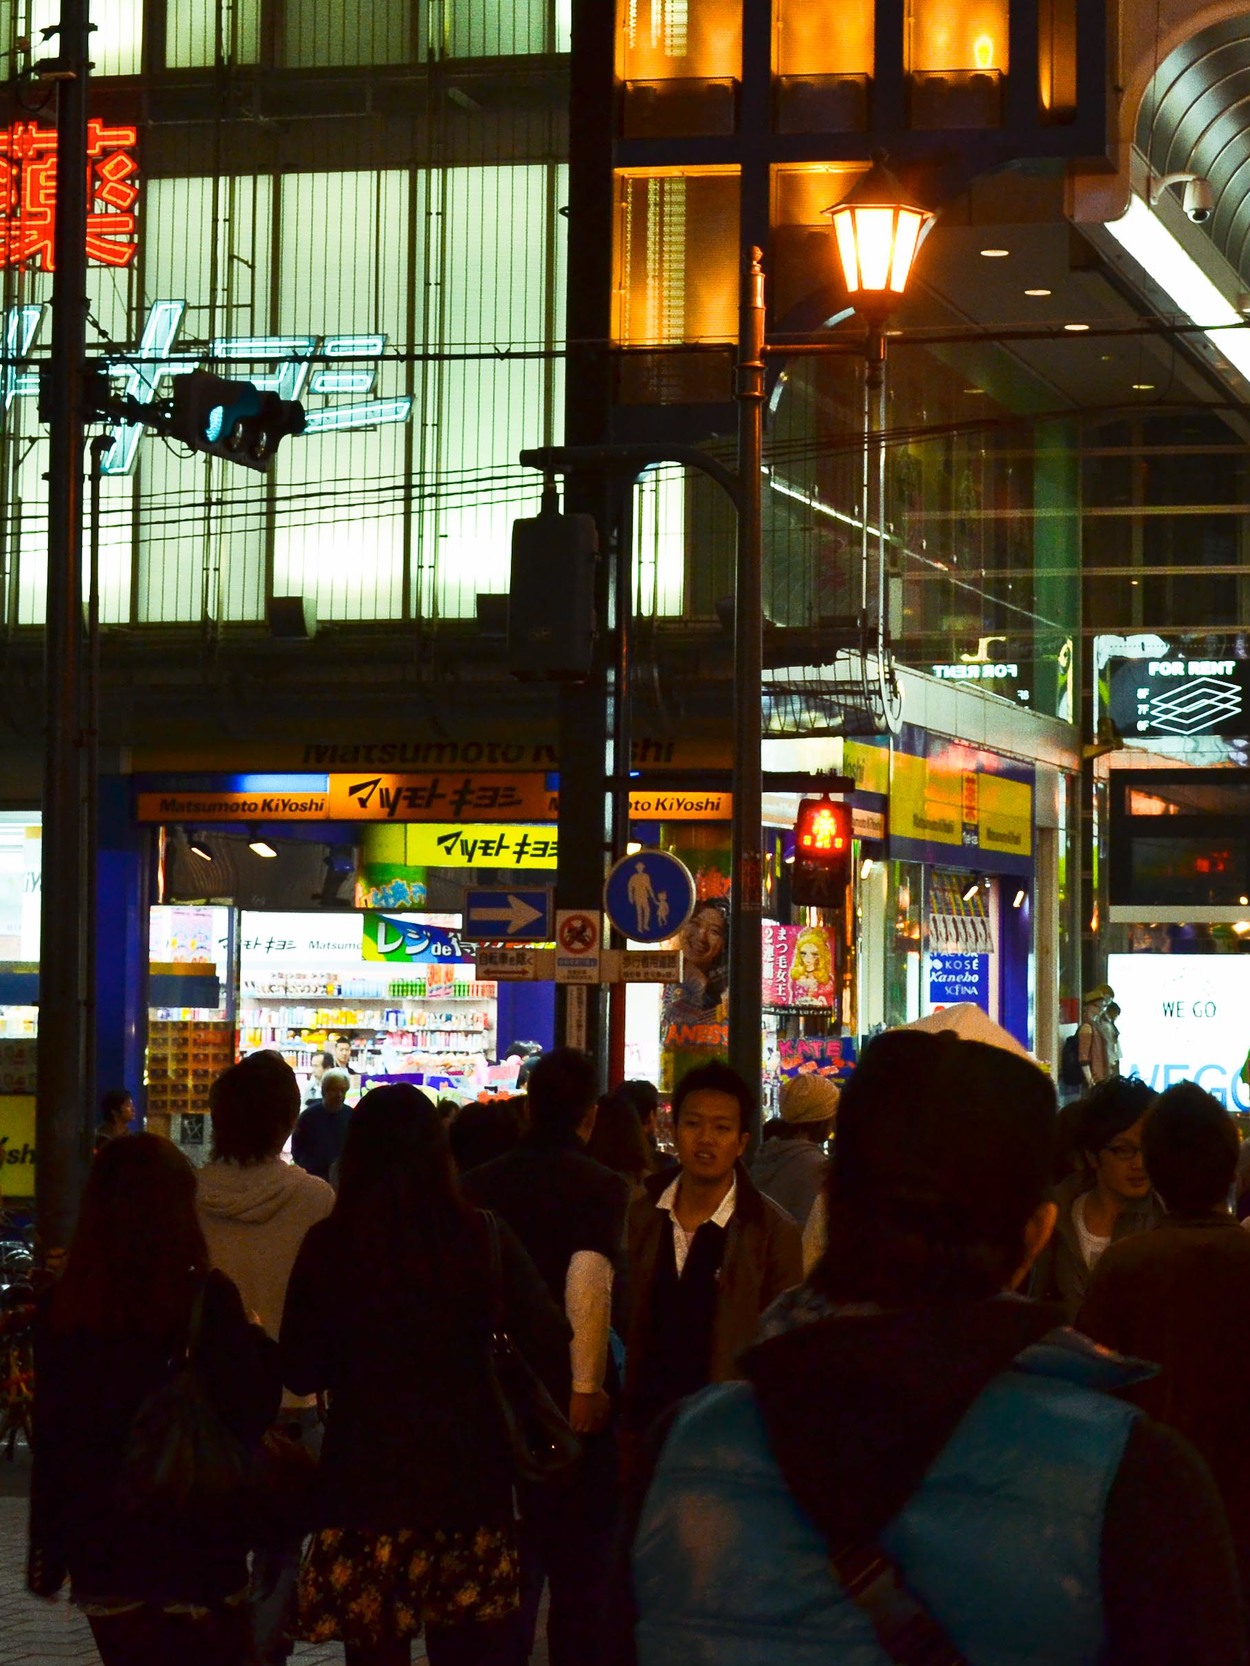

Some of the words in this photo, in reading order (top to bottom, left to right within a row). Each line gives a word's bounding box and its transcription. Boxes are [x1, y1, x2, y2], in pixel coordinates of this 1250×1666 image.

[1148, 661, 1185, 676] FOR
[1187, 660, 1236, 676] RENT
[348, 777, 523, 817] マツモトキヨシ
[159, 798, 258, 813] Matsumoto
[930, 971, 979, 983] Kanebo
[777, 1038, 843, 1058] KATE
